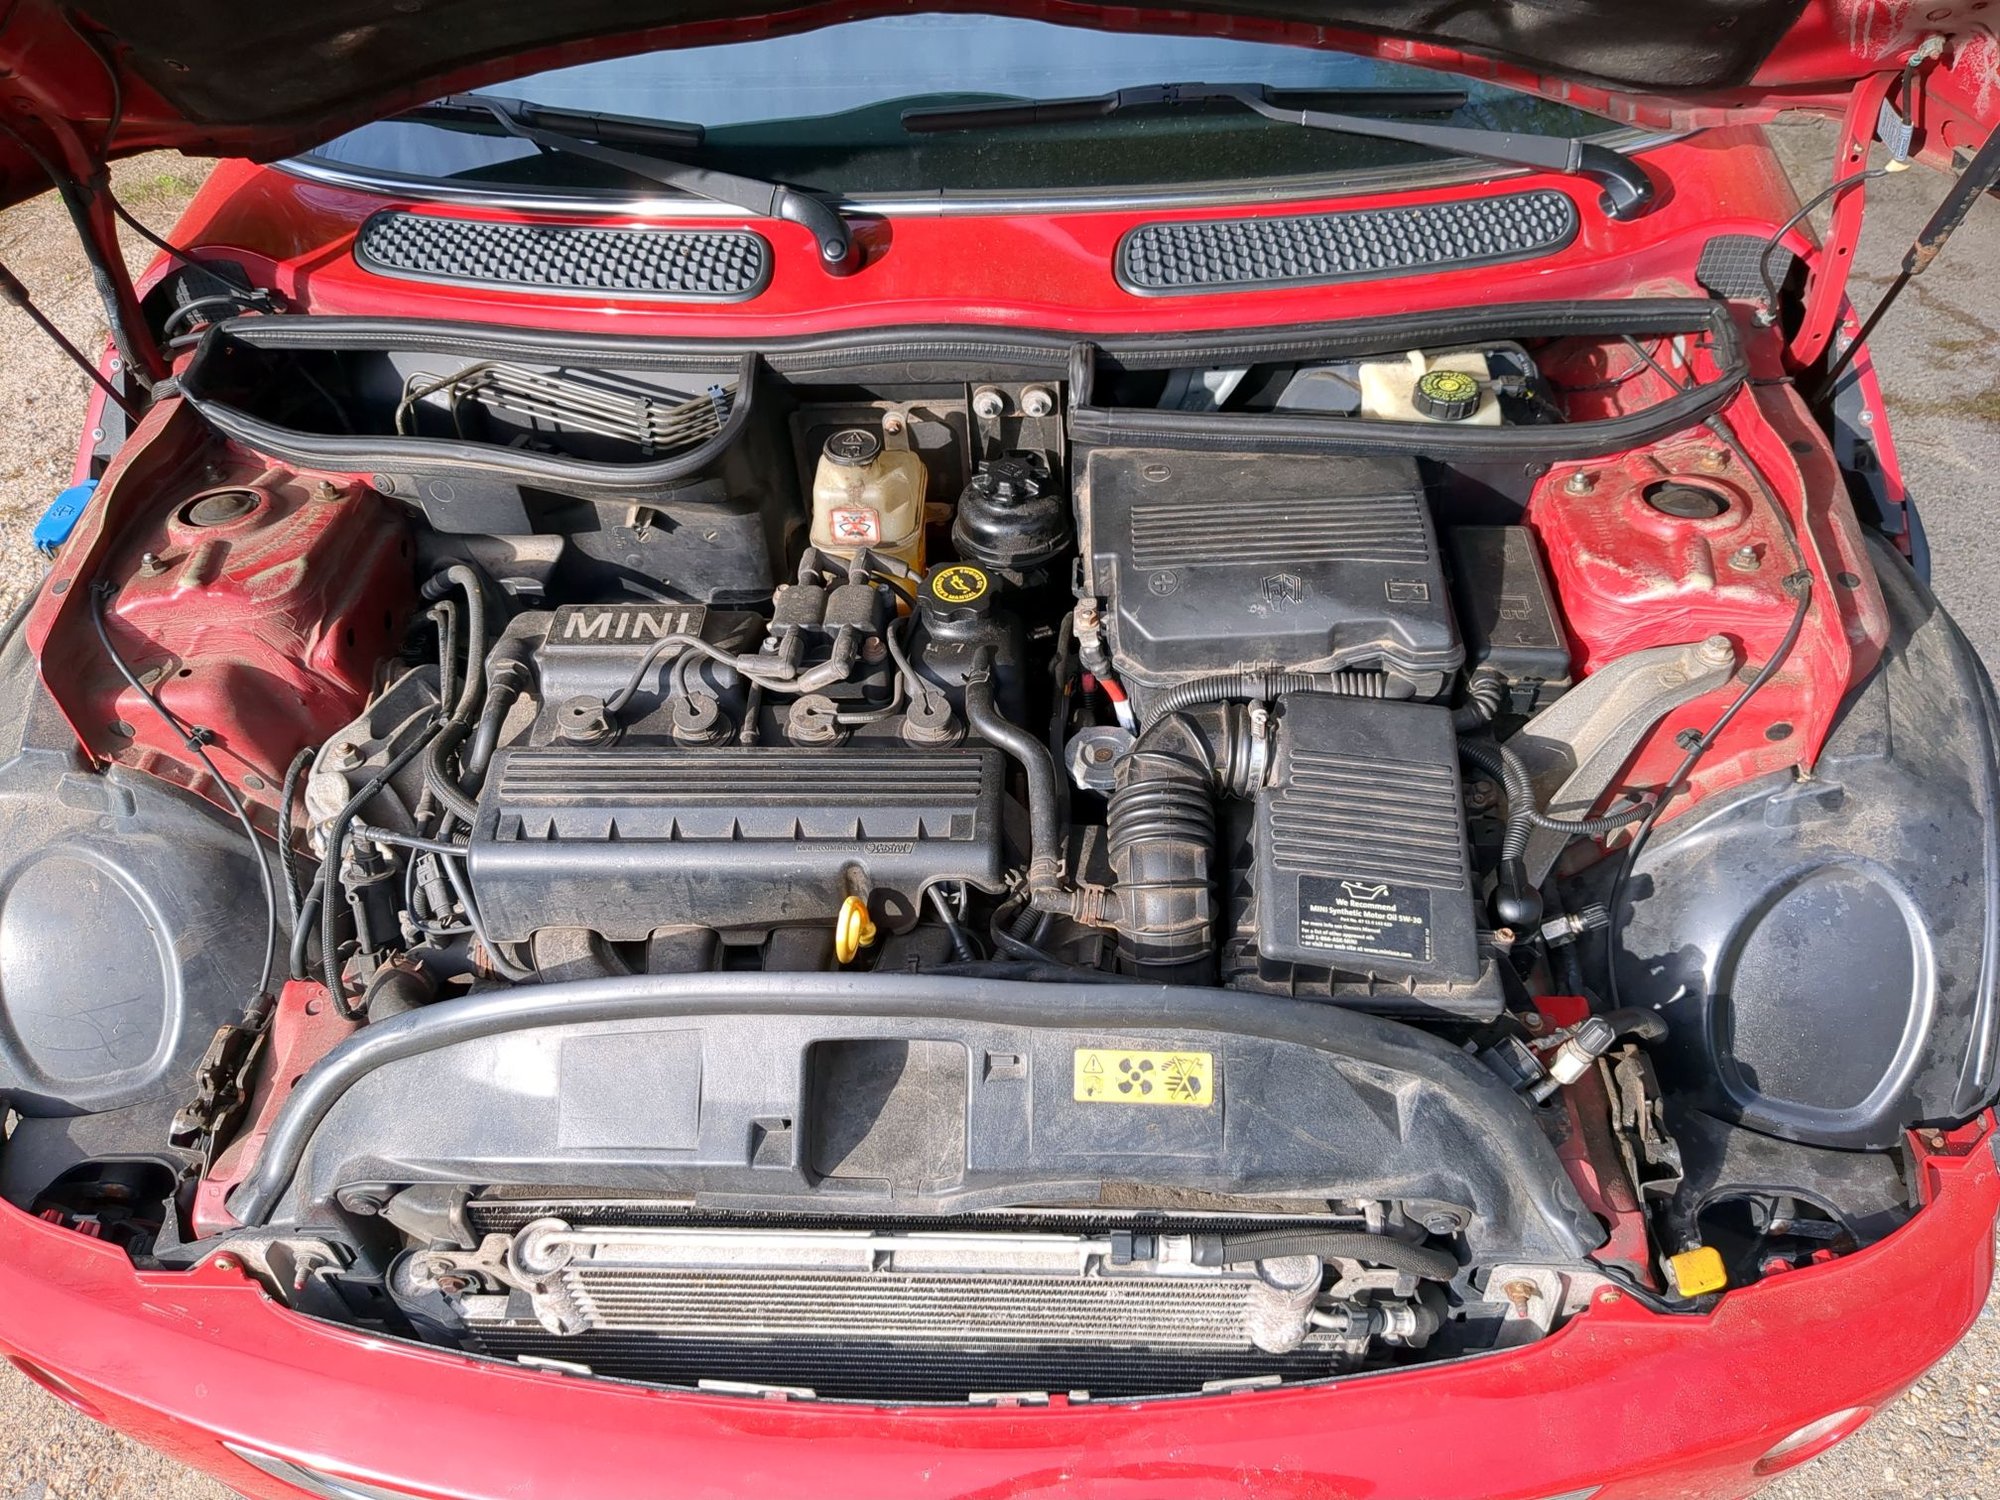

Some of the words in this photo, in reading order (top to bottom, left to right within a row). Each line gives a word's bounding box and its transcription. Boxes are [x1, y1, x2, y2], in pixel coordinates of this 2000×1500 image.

[948, 591, 977, 600] MANUAL
[563, 612, 690, 638] MINI
[1335, 898, 1348, 907] We
[1350, 900, 1397, 912] Recommend
[1310, 904, 1328, 913] MINI
[1329, 906, 1362, 917] Synthetic
[1363, 910, 1386, 920] Motor
[1386, 913, 1398, 921] Oil
[1398, 914, 1422, 924] 5W-30
[1362, 926, 1381, 934] Manual
